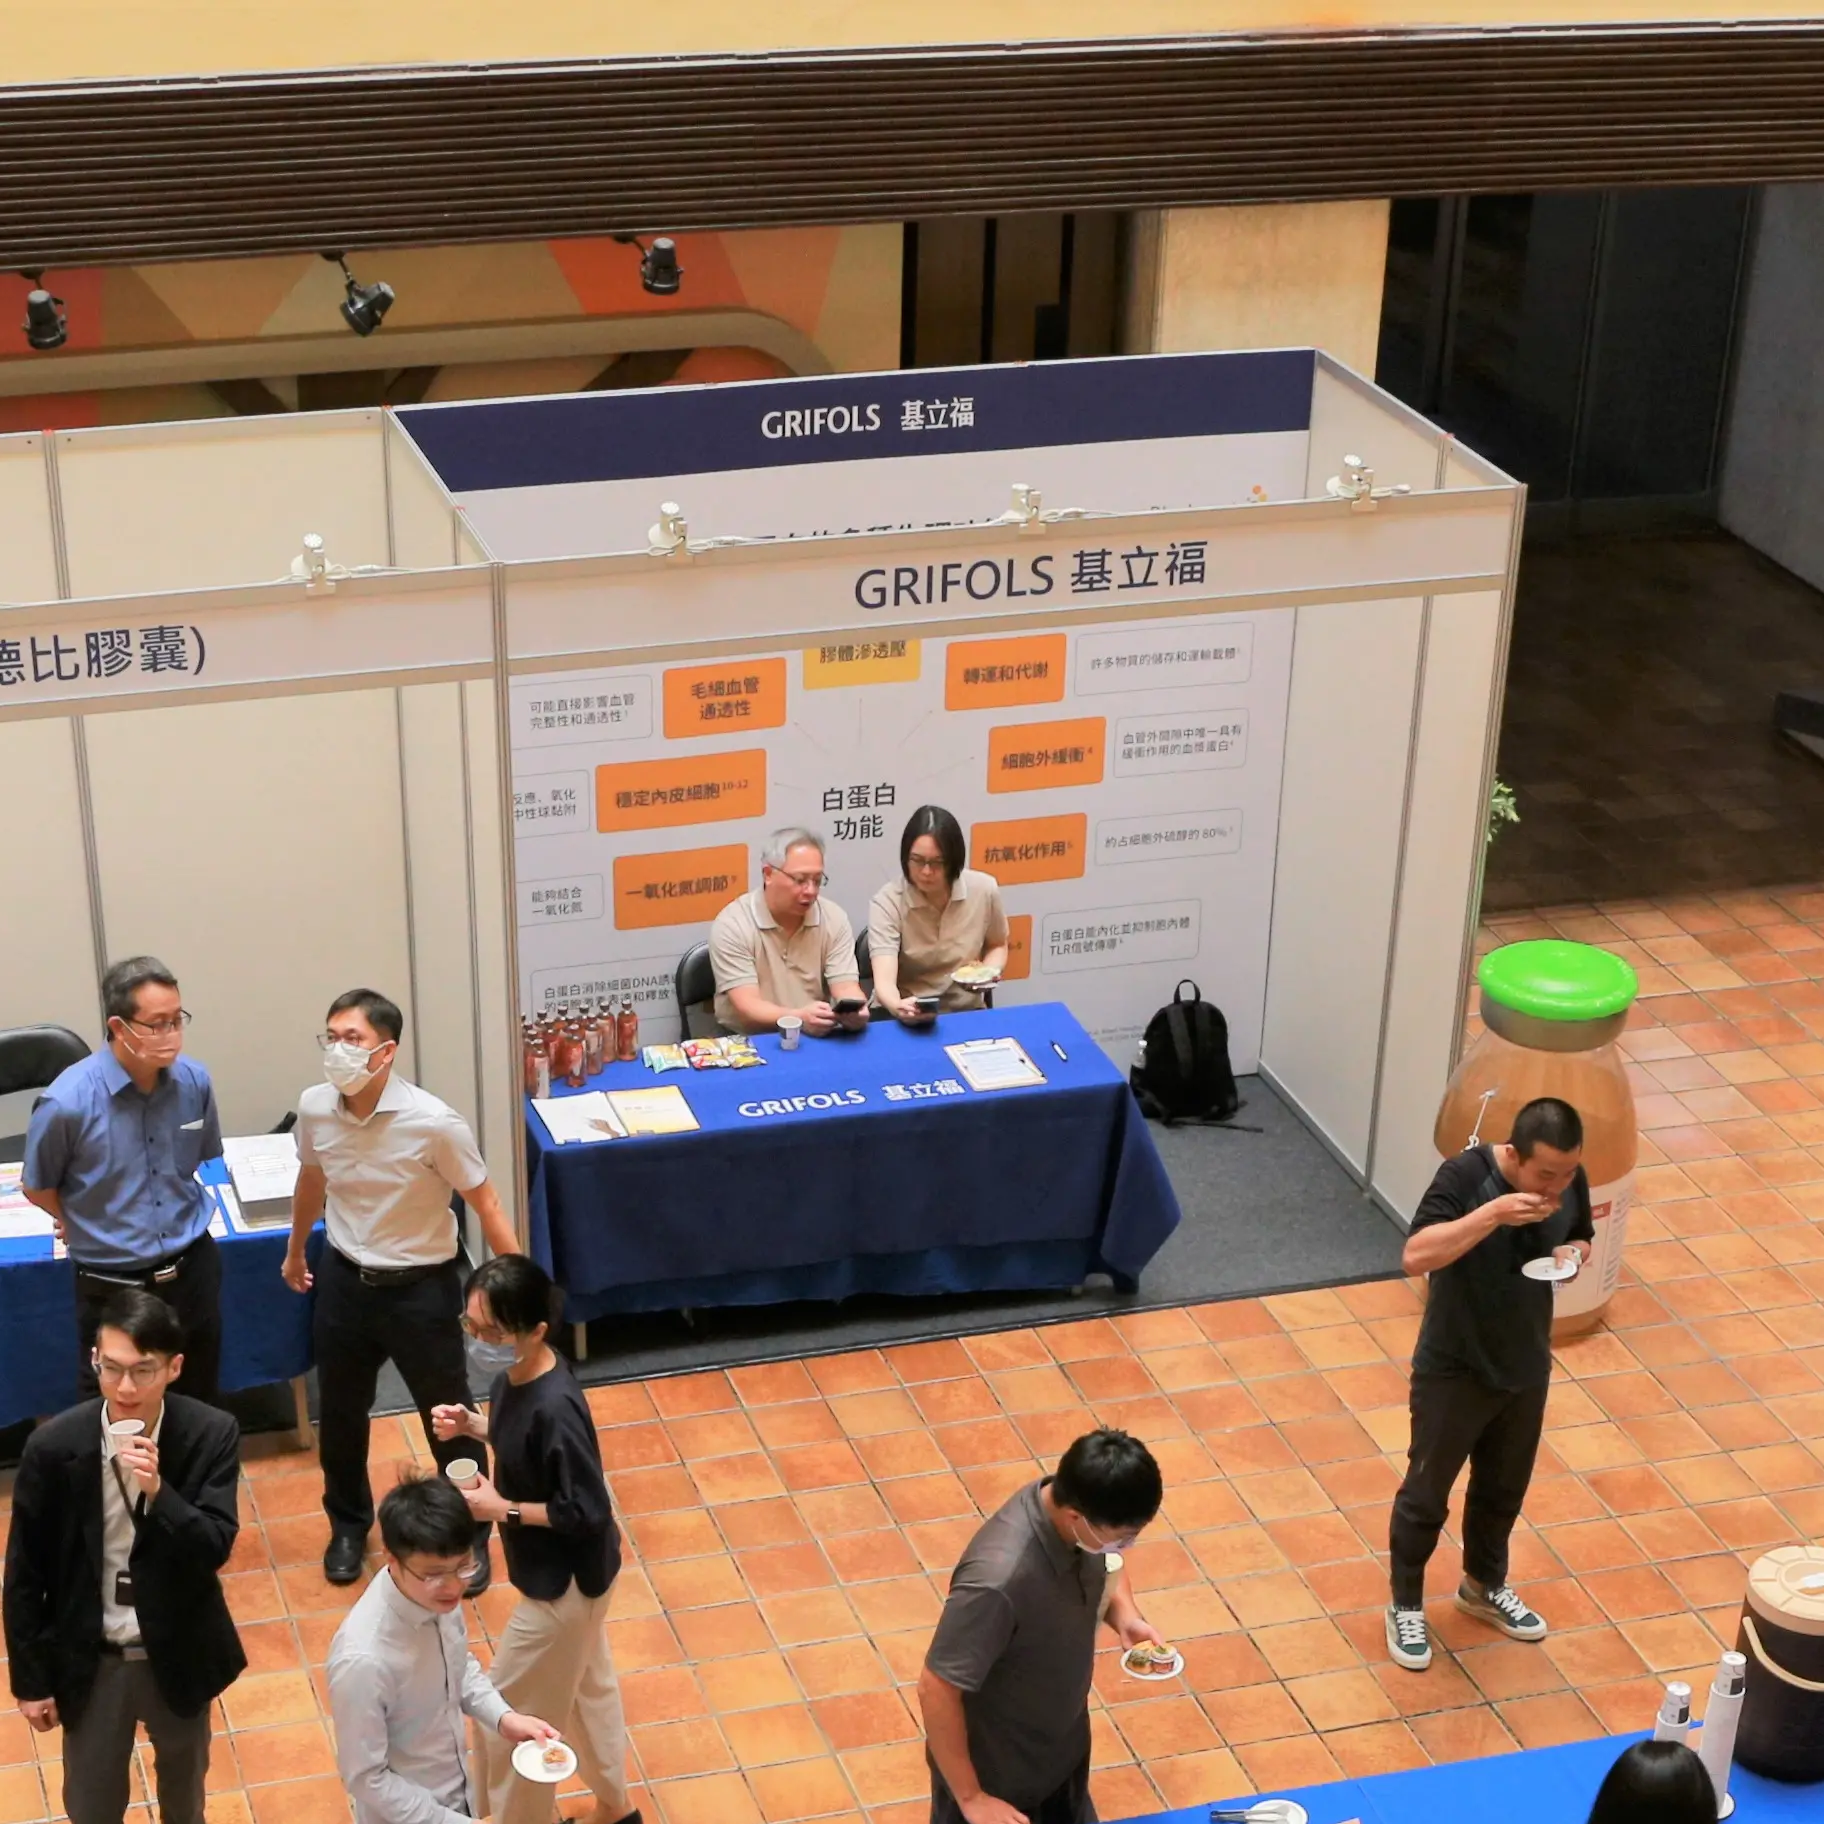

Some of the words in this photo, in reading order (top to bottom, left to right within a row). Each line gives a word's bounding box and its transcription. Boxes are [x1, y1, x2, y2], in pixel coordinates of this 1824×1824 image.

[761, 404, 881, 439] GRIFOLS
[900, 397, 975, 432] 基立福
[855, 555, 1054, 610] GRIFOLS
[1071, 541, 1209, 593] 基立福
[691, 676, 760, 698] 毛細血管
[963, 661, 1048, 685] 轉運和代謝
[700, 700, 751, 721] 通透性
[823, 782, 896, 812] 白蛋白
[833, 814, 884, 841] 功能
[737, 1088, 866, 1119] GRIFOLS
[881, 1078, 969, 1104] 基立福
